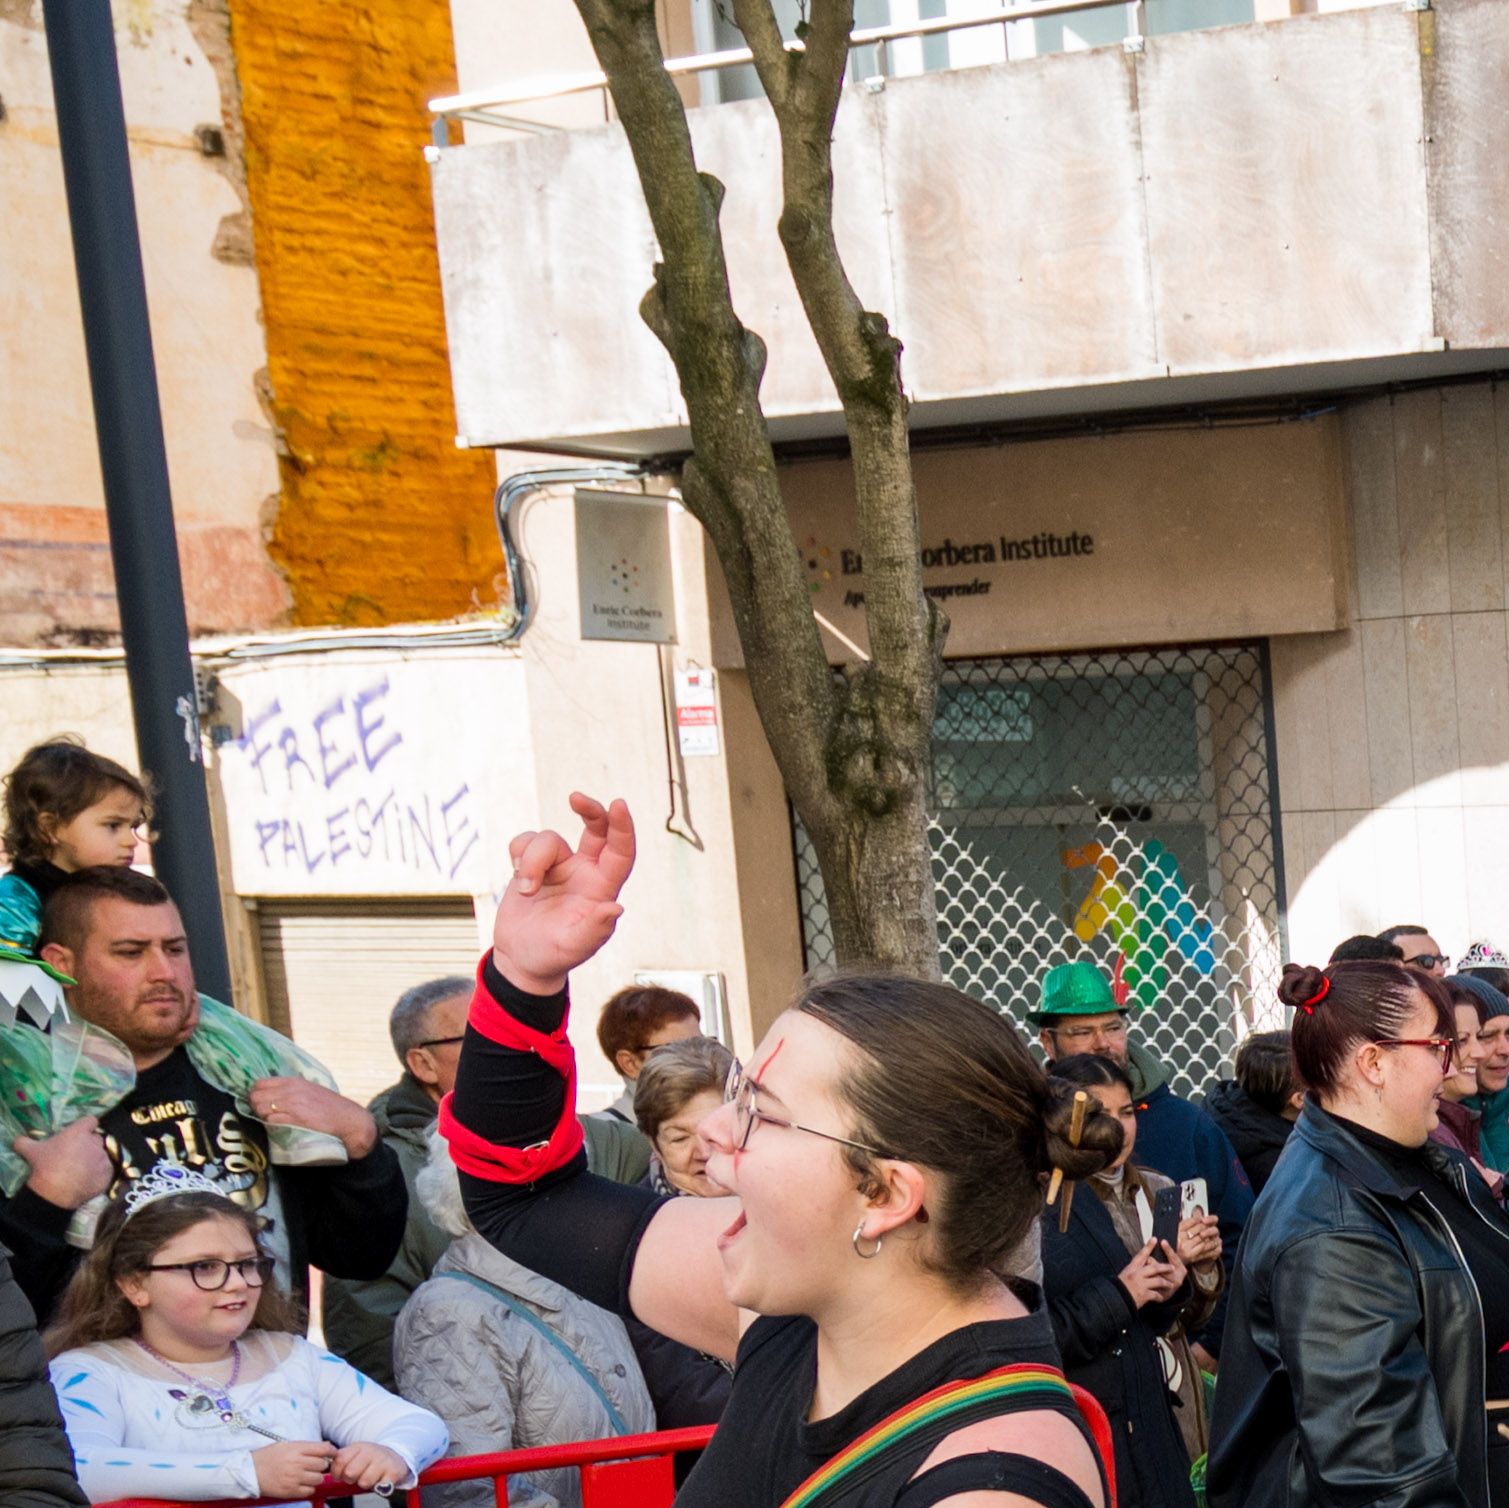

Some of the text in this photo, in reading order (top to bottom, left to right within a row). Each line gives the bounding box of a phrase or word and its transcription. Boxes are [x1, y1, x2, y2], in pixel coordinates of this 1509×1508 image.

[921, 531, 1094, 568] orbera Institute
[621, 606, 663, 619] Corbera
[238, 674, 402, 796] FREE
